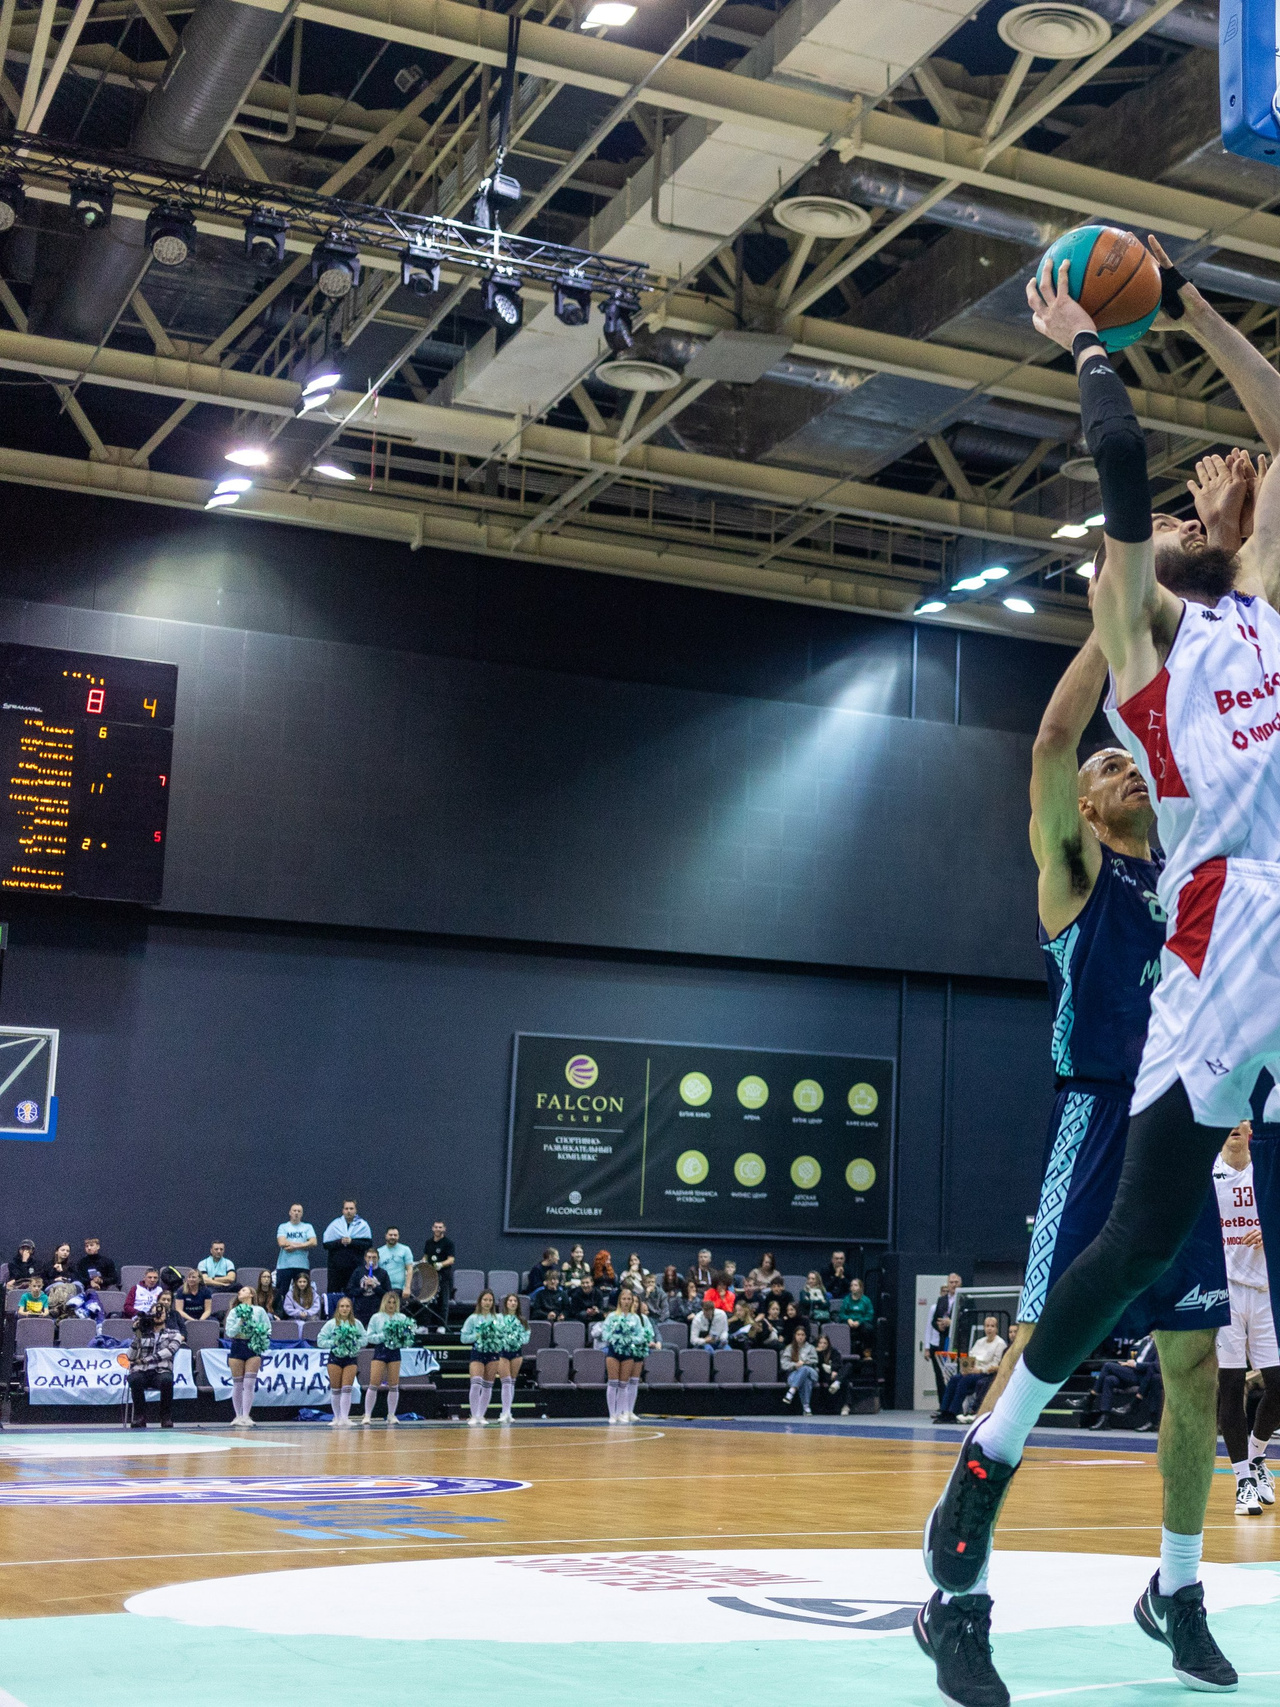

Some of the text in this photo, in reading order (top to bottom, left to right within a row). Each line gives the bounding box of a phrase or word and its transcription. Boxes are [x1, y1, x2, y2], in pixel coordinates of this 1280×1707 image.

[86, 689, 157, 718] 8 4
[536, 1092, 624, 1113] FALCON
[556, 1113, 602, 1123] CLUB
[1232, 1186, 1255, 1208] 33
[546, 1206, 603, 1216] FALCONCLUB.BY
[1220, 1216, 1261, 1228] BetBoo
[57, 1358, 112, 1371] ОДНО
[34, 1374, 88, 1388] ОДНА
[495, 1558, 727, 1592] BELARUS
